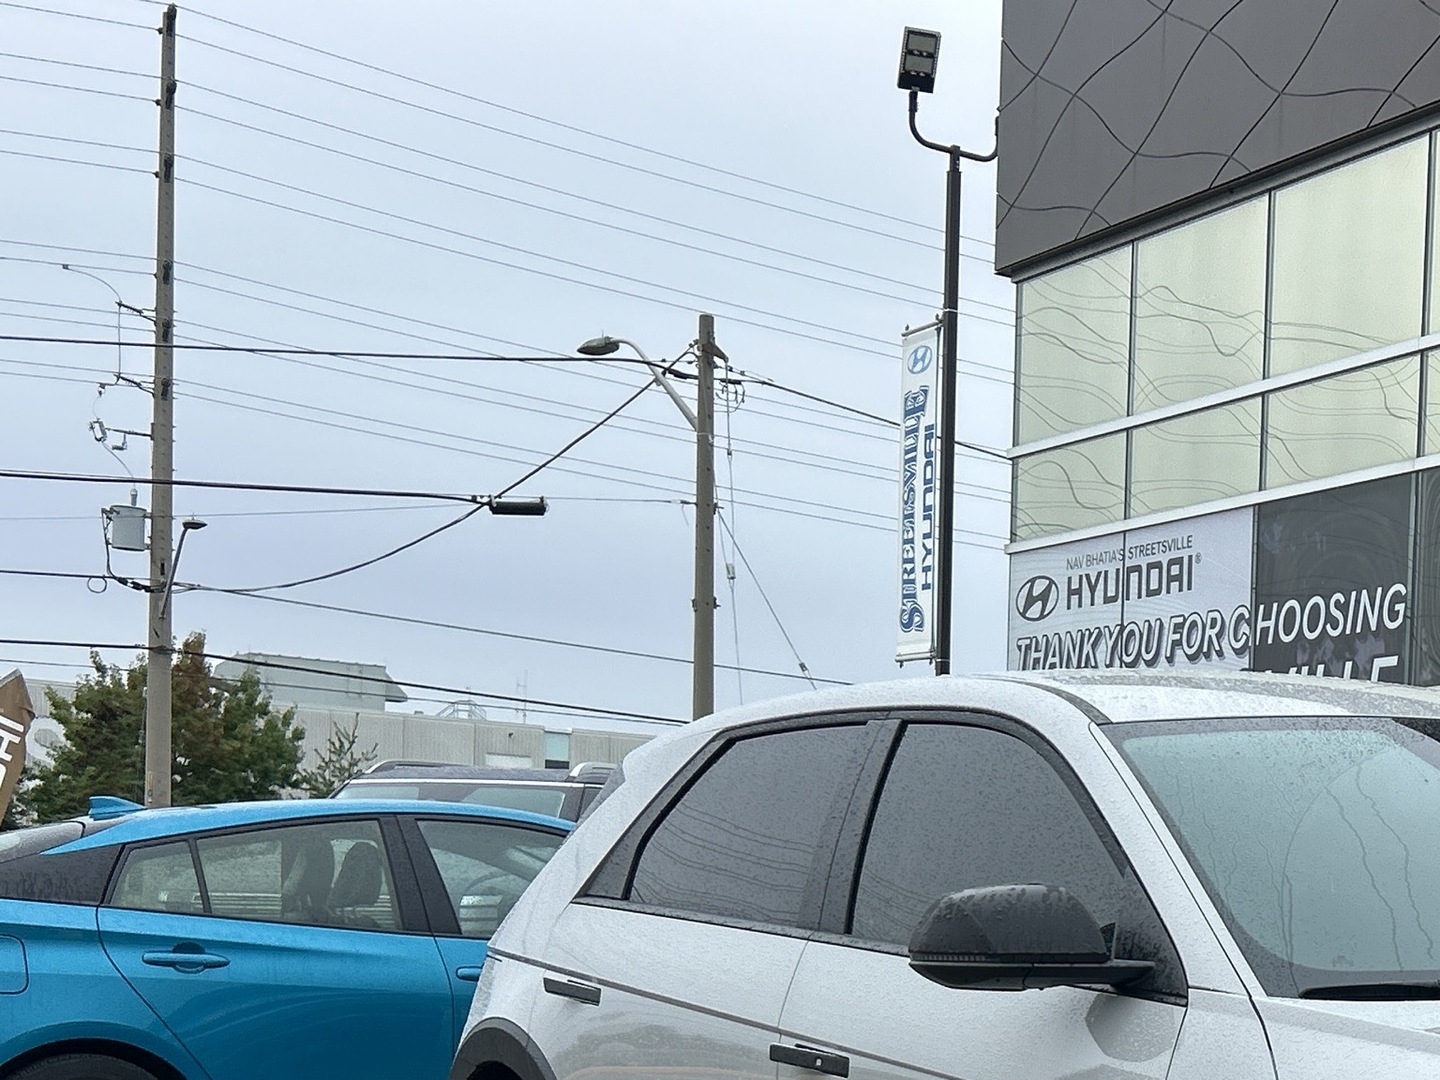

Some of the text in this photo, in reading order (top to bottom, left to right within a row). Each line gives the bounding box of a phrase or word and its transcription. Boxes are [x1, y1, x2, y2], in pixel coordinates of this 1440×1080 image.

[921, 423, 935, 592] HYUNDAI
[1066, 534, 1193, 571] NAV BHATIA'S STREETSVILLE
[1016, 583, 1408, 671] THANK YOU FOR CHOOSING
